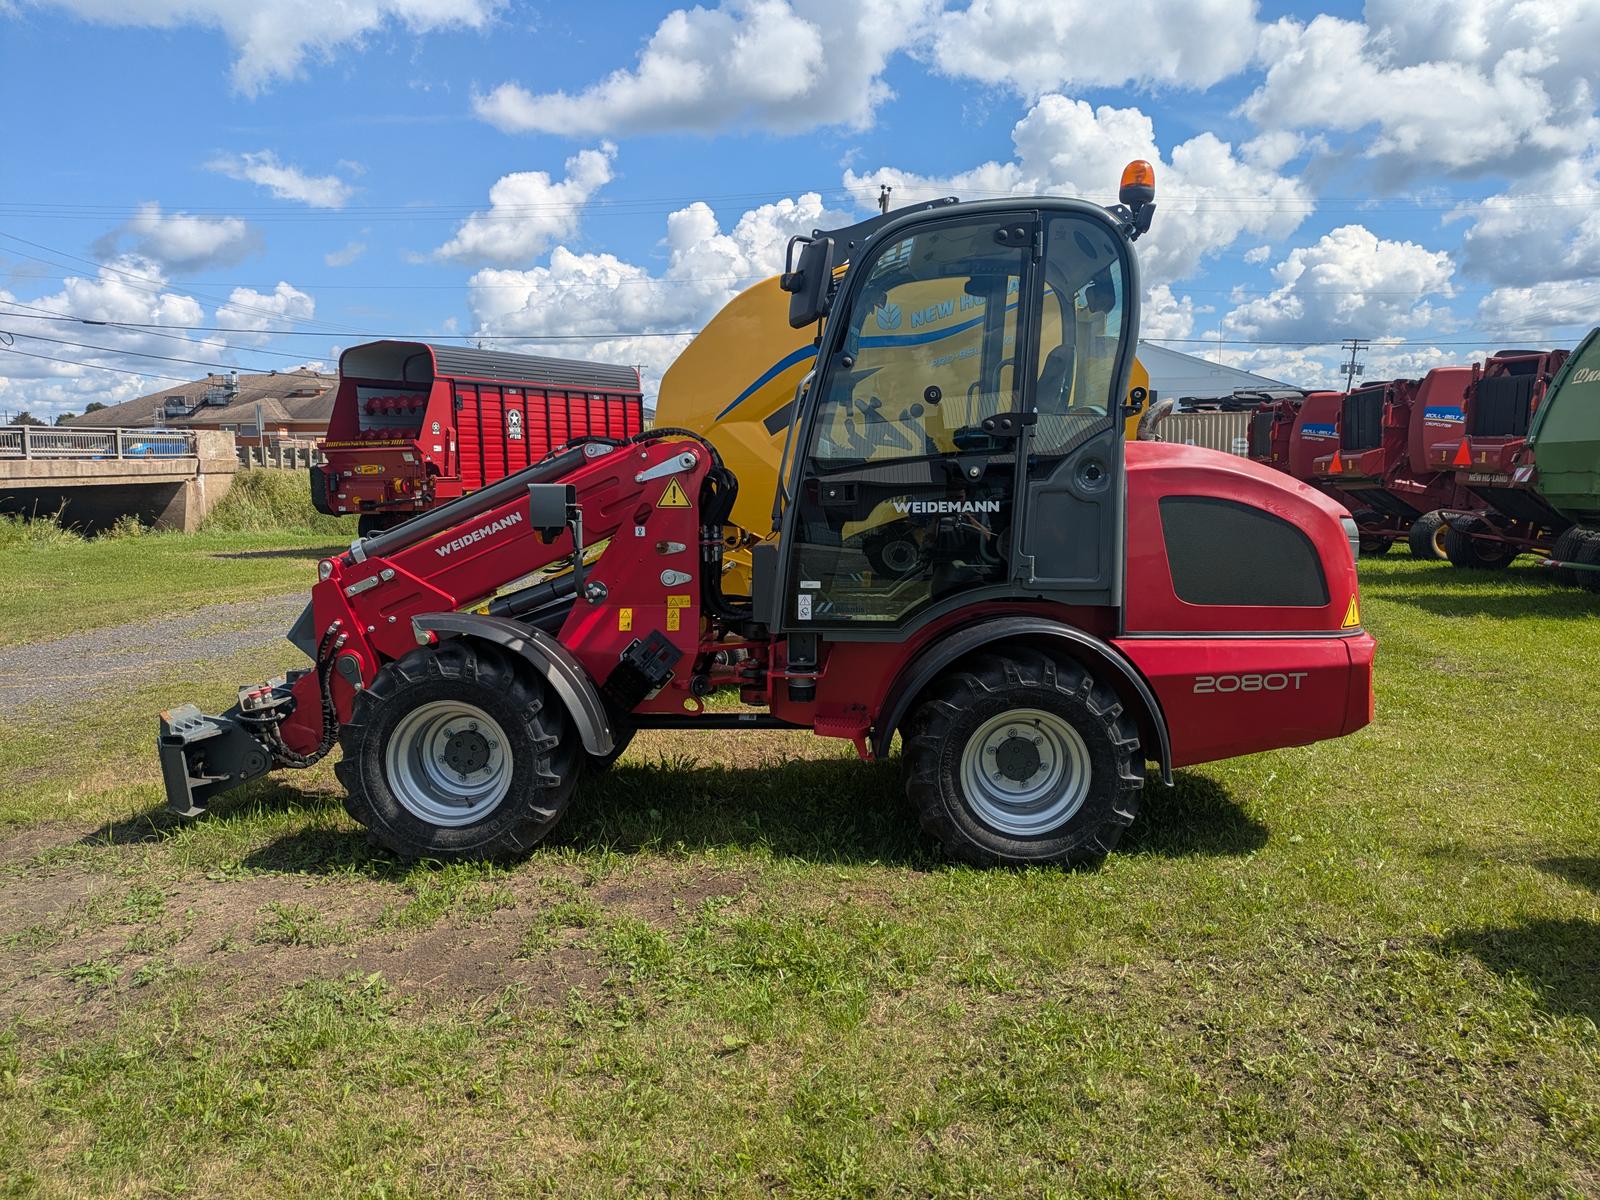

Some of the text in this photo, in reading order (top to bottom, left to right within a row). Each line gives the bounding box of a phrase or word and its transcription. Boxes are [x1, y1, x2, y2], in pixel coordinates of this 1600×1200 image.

[911, 299, 955, 329] NEW
[893, 500, 1000, 513] WEIDEMANN
[435, 512, 523, 557] WEIDEMANN
[1193, 672, 1308, 693] 2080T
